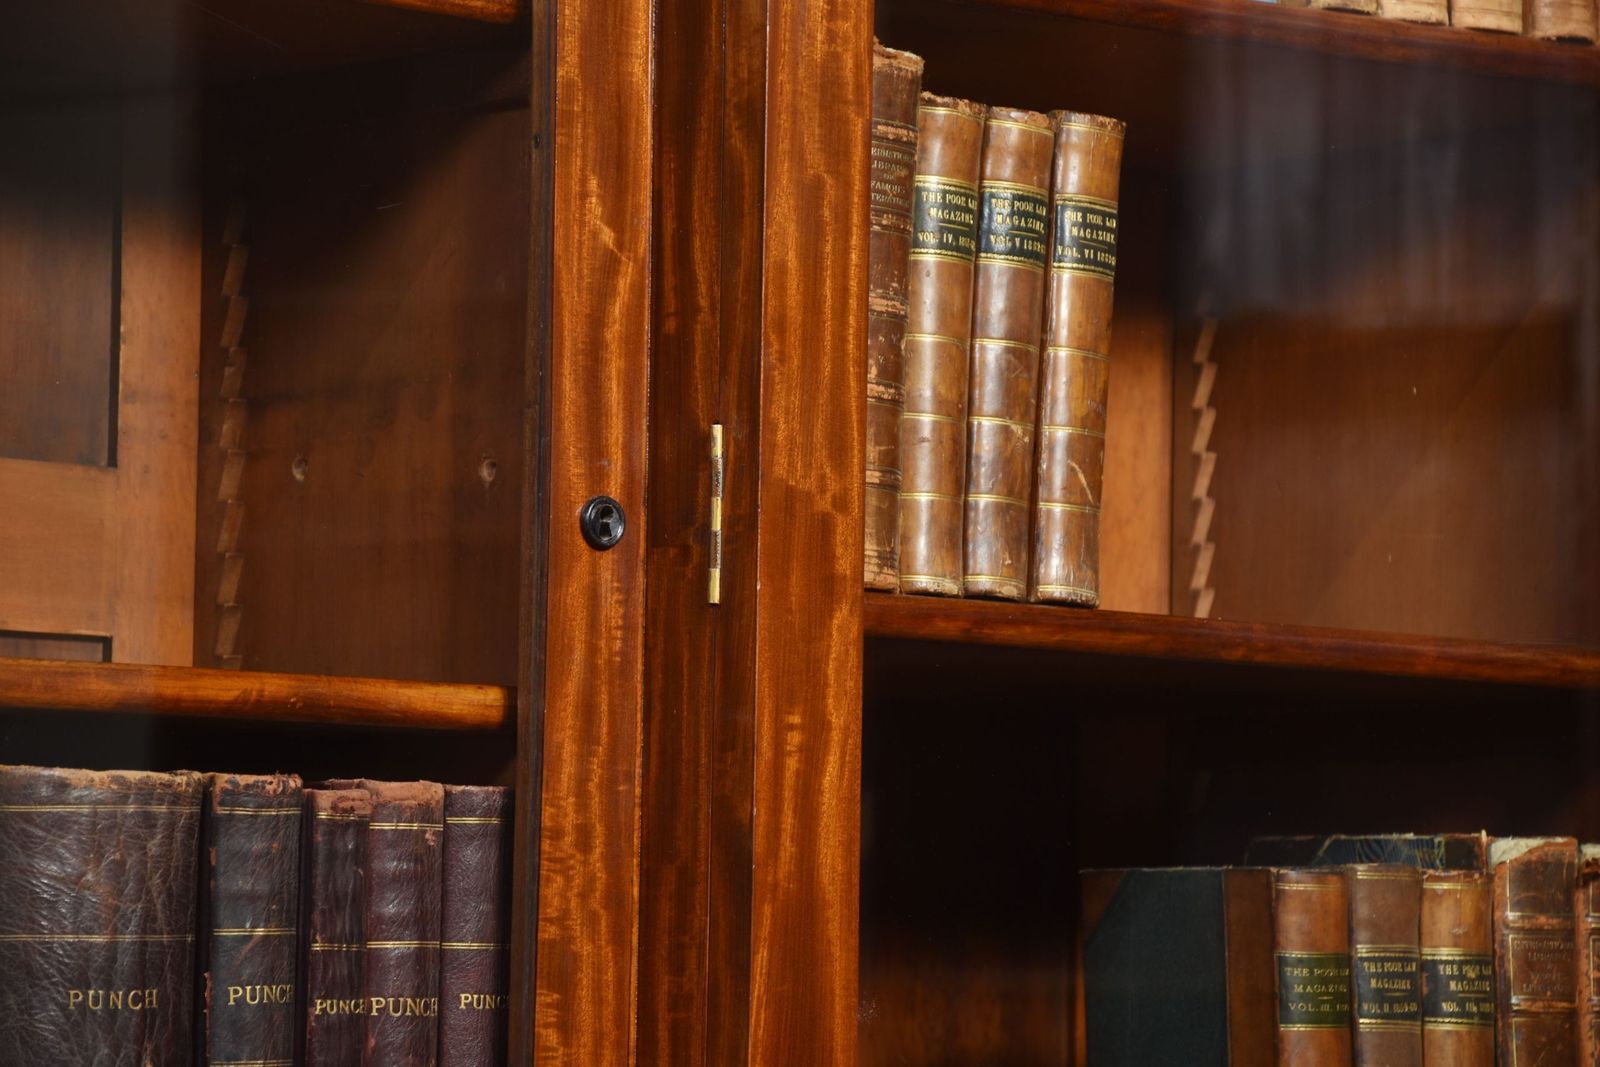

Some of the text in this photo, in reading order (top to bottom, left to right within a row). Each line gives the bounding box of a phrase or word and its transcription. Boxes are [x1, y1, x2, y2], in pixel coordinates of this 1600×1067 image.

[921, 191, 943, 203] THE
[945, 193, 966, 207] POOR
[990, 198, 1011, 212] THE
[1013, 200, 1034, 212] POOR
[1064, 208, 1083, 224] THE
[1086, 213, 1104, 226] POOR
[1014, 237, 1021, 248] V
[1057, 245, 1081, 258] VOL.
[1084, 248, 1094, 260] VI
[1283, 967, 1311, 977] THE
[1364, 961, 1382, 972] THE
[1383, 961, 1403, 972] POOR
[1437, 964, 1460, 976] THE
[68, 988, 159, 1010] PUNCH
[228, 984, 293, 1006] PUNCH
[370, 996, 439, 1017] PUNCH
[1287, 1003, 1319, 1012] VOL.
